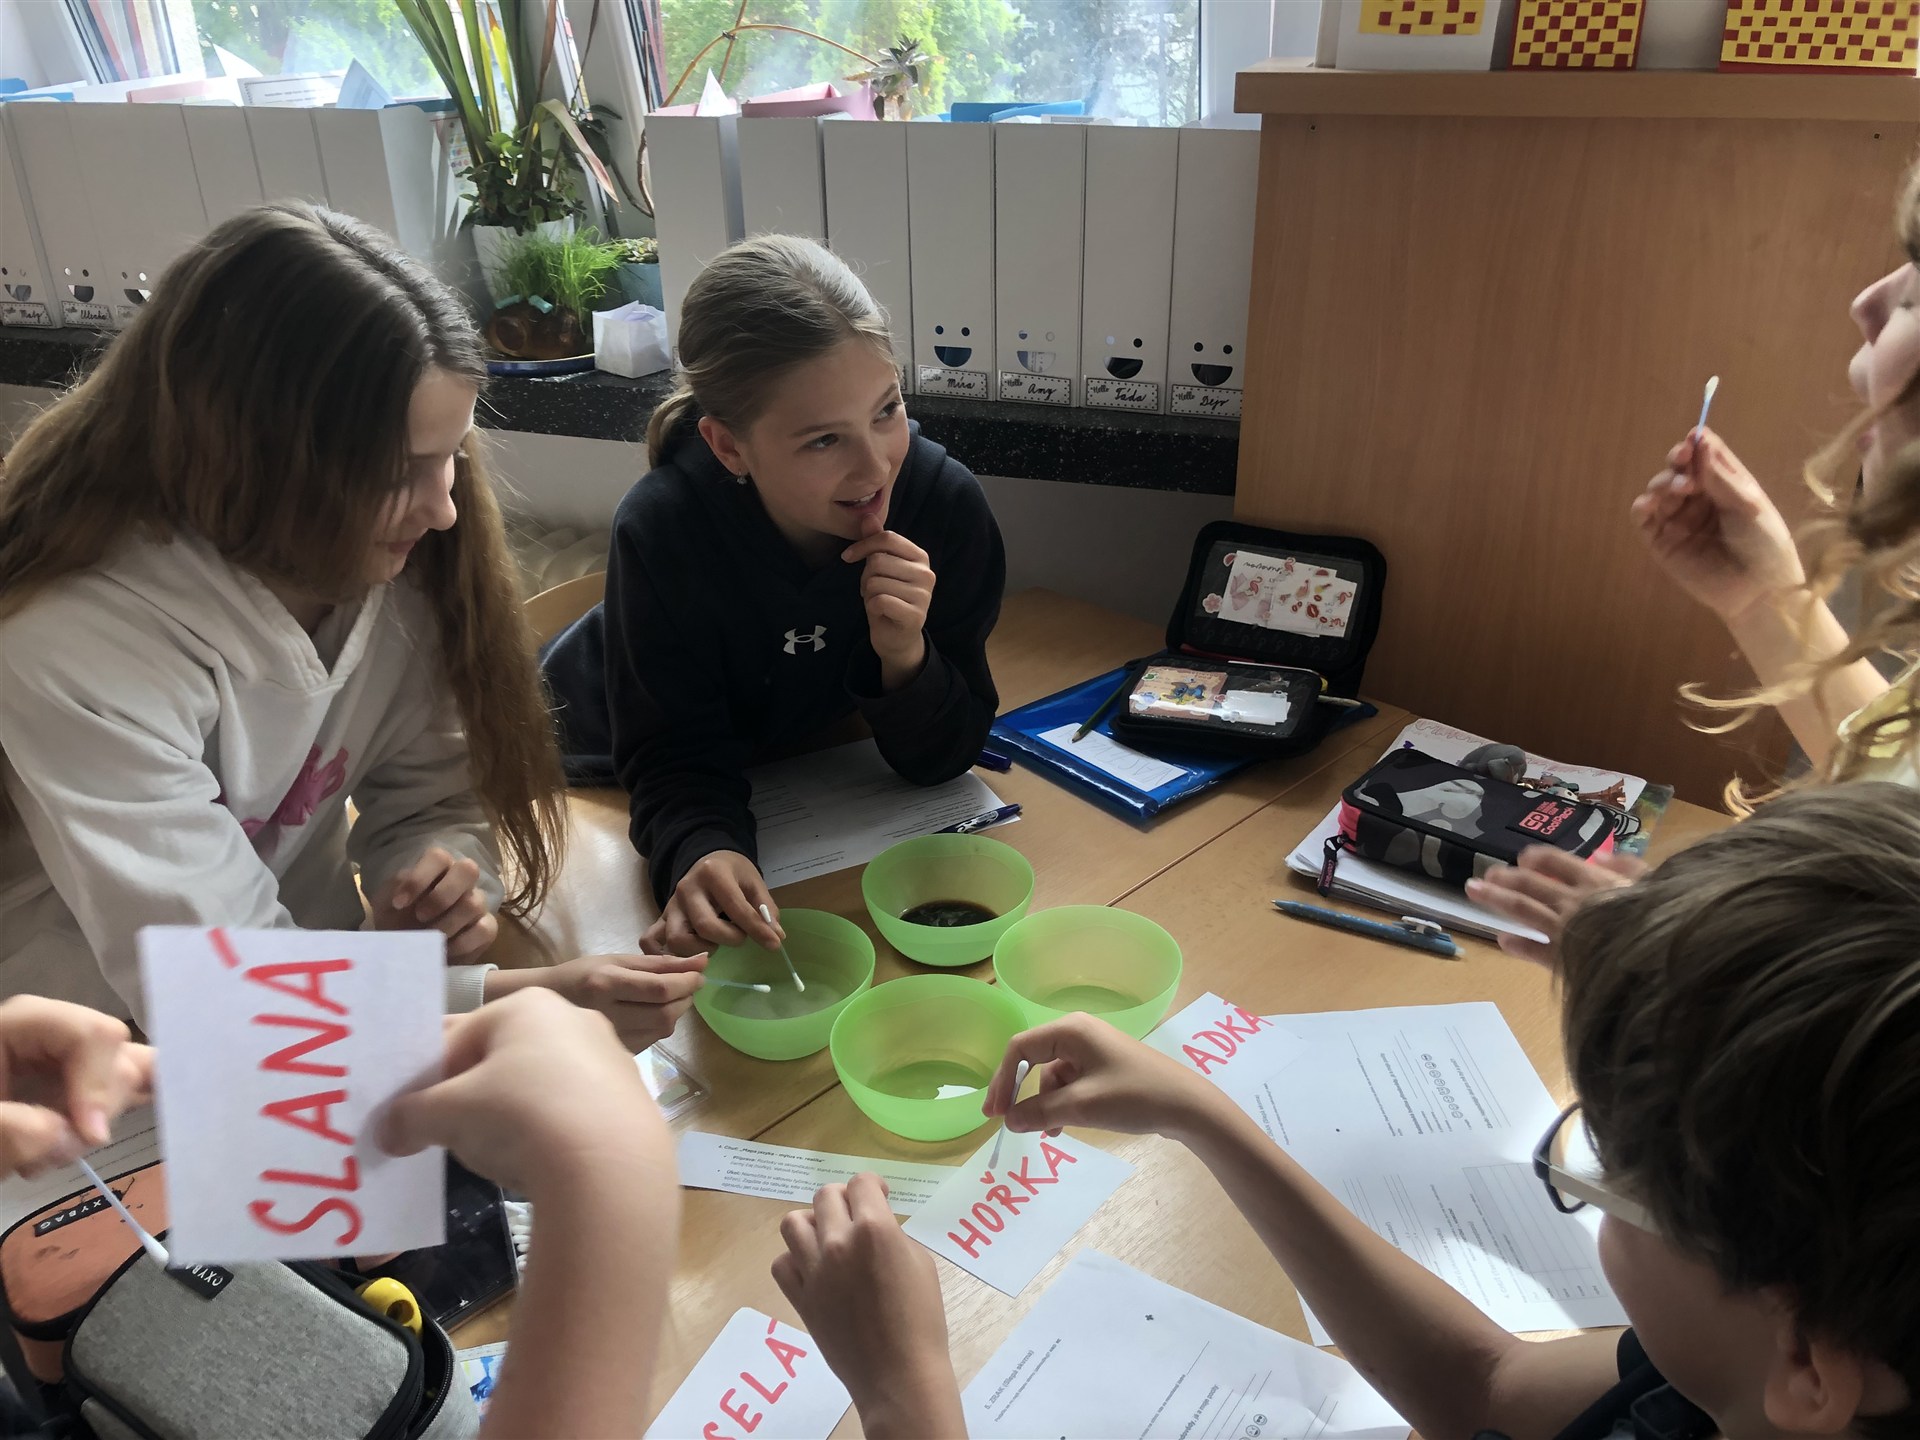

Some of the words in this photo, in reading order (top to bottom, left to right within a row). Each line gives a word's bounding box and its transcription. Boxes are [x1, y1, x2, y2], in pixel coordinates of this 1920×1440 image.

[1093, 385, 1110, 394] Hello
[1178, 391, 1196, 401] Hello
[1540, 806, 1576, 835] CoolPack
[1182, 1000, 1274, 1075] ADKÁ
[206, 927, 364, 1246] SLANÁ
[947, 1131, 1078, 1259] HOŘKÁ
[39, 1199, 102, 1230] XYBAG
[185, 1263, 223, 1287] OXYB
[703, 1319, 807, 1440] SELÁ
